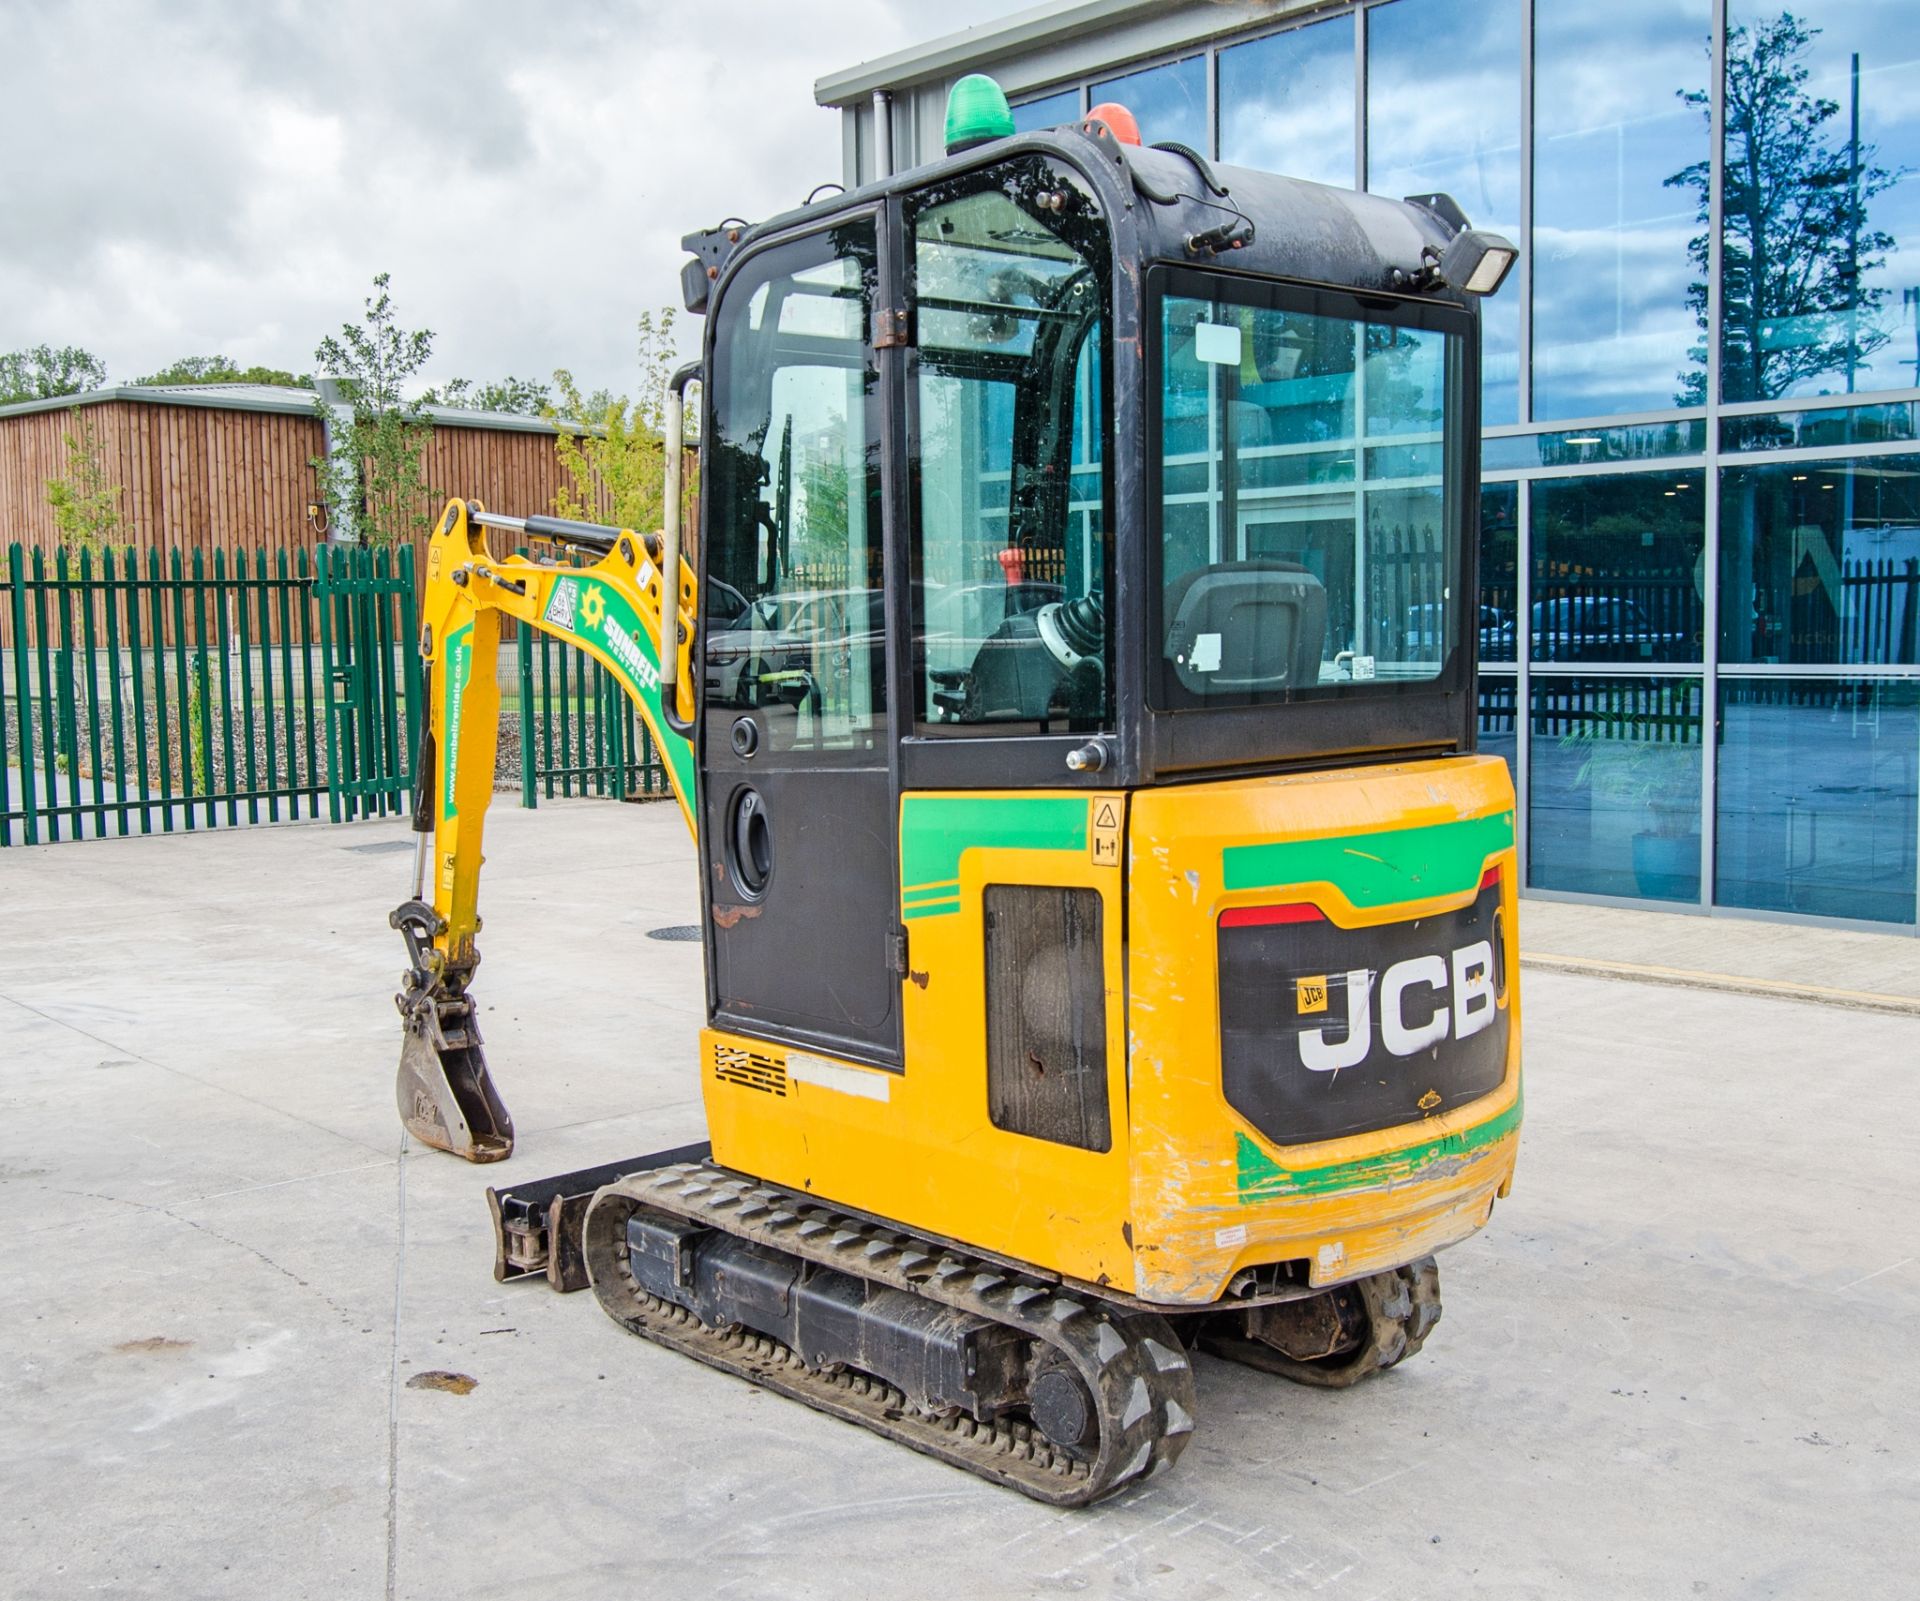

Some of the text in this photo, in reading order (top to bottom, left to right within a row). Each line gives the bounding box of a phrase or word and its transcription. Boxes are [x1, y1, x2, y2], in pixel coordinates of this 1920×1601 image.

[603, 614, 659, 689] SUNBELT
[607, 638, 646, 688] RENTALS
[448, 646, 463, 803] www.sunbeltrentals.co.uk
[1298, 940, 1495, 1071] JCB
[1303, 986, 1324, 1006] JCB
